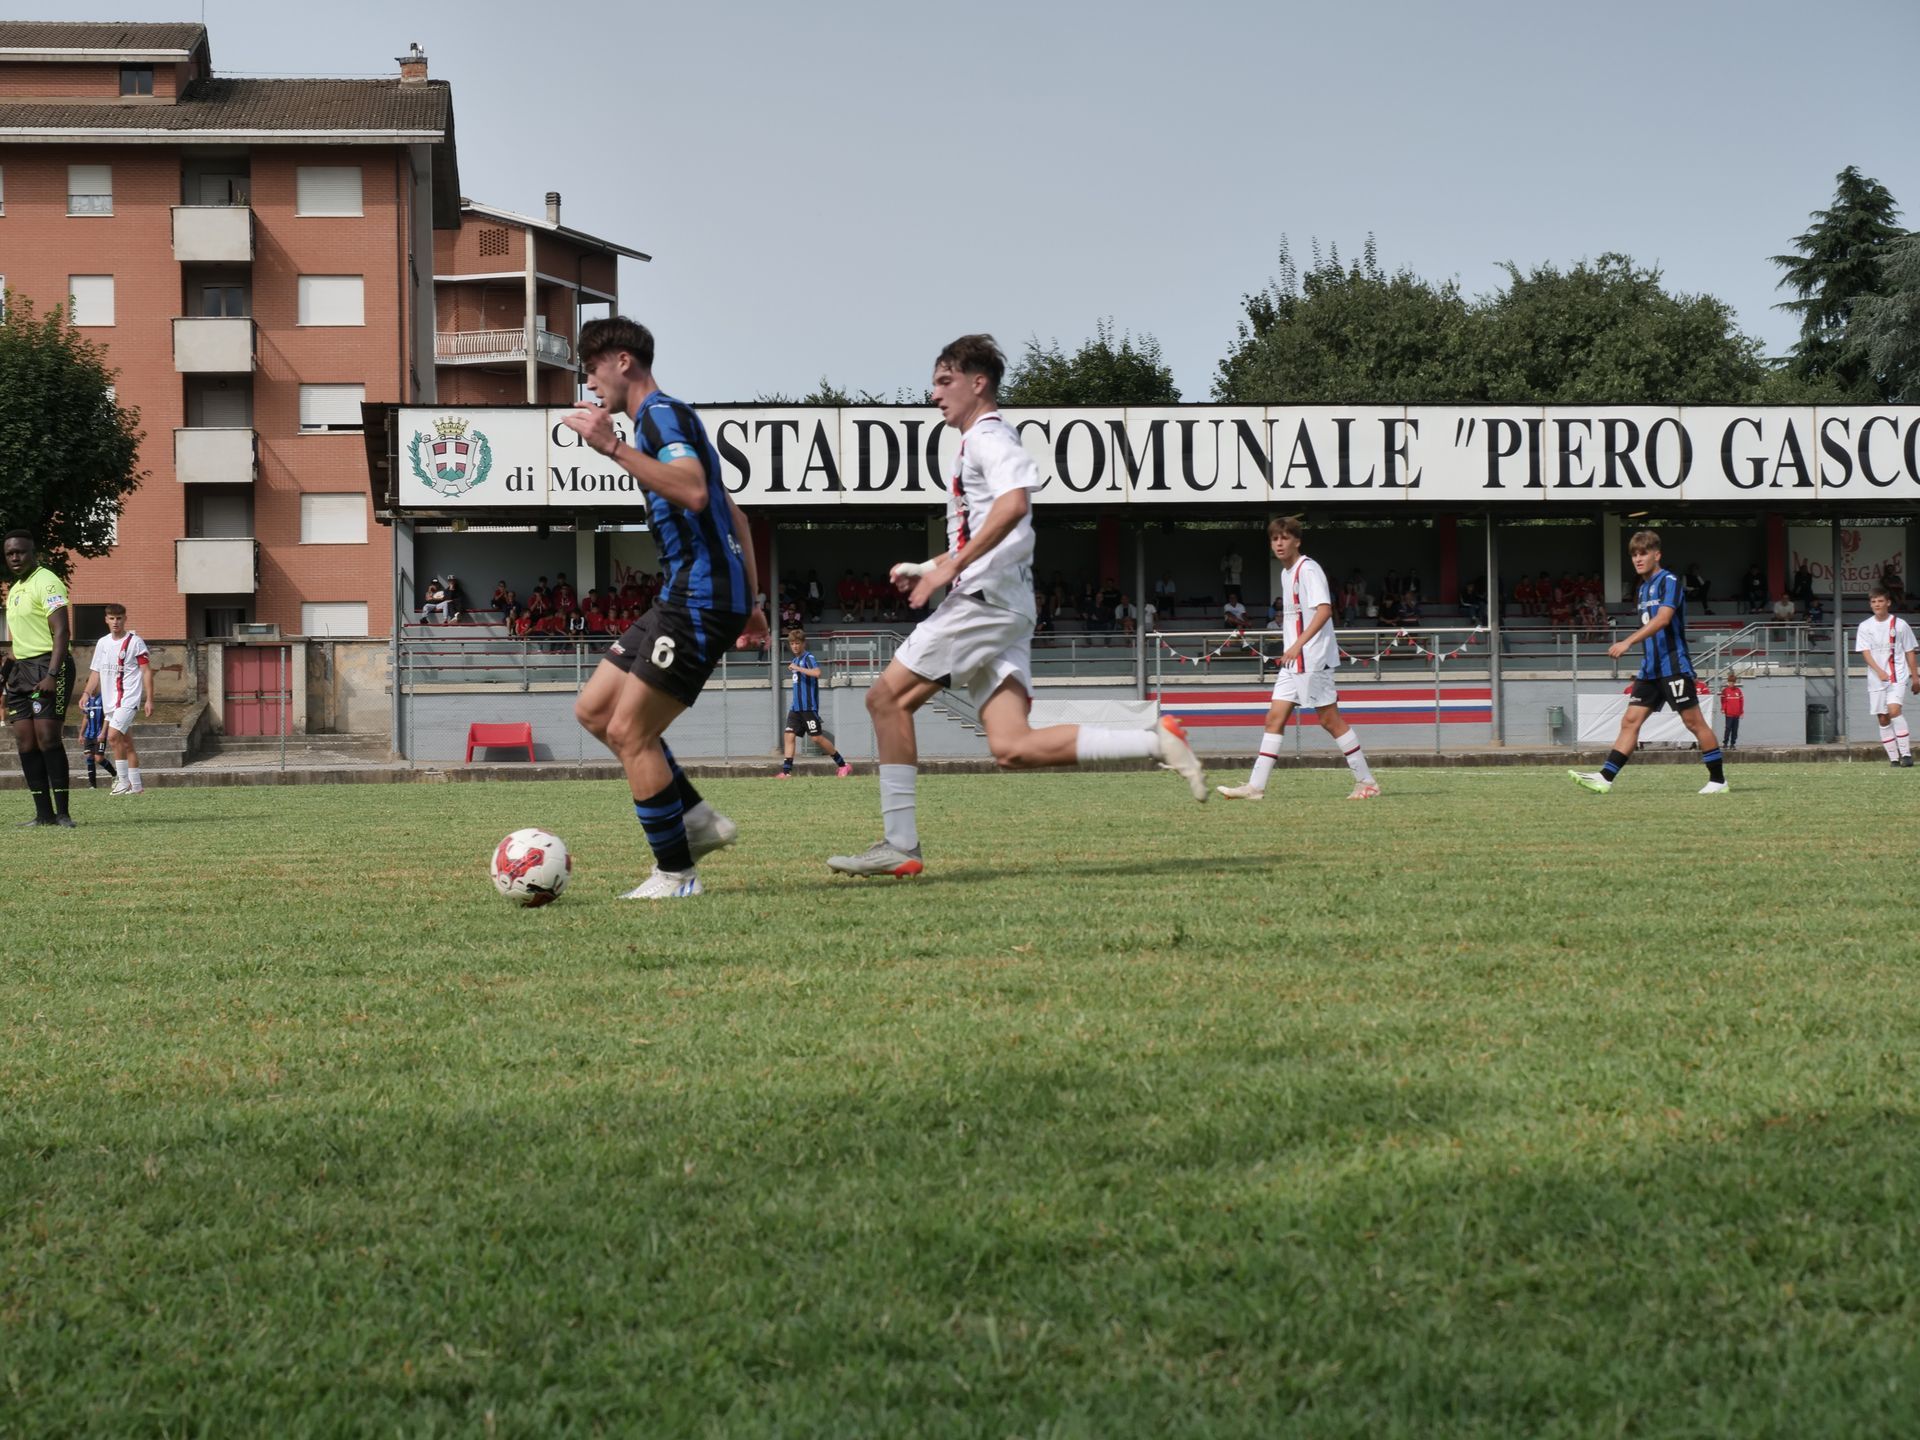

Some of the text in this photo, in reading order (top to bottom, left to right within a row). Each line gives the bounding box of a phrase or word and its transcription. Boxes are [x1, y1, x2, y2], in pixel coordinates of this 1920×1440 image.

[505, 466, 637, 492] di Mond
[651, 635, 676, 669] 6
[1668, 678, 1685, 698] 17
[806, 719, 817, 730] 18
